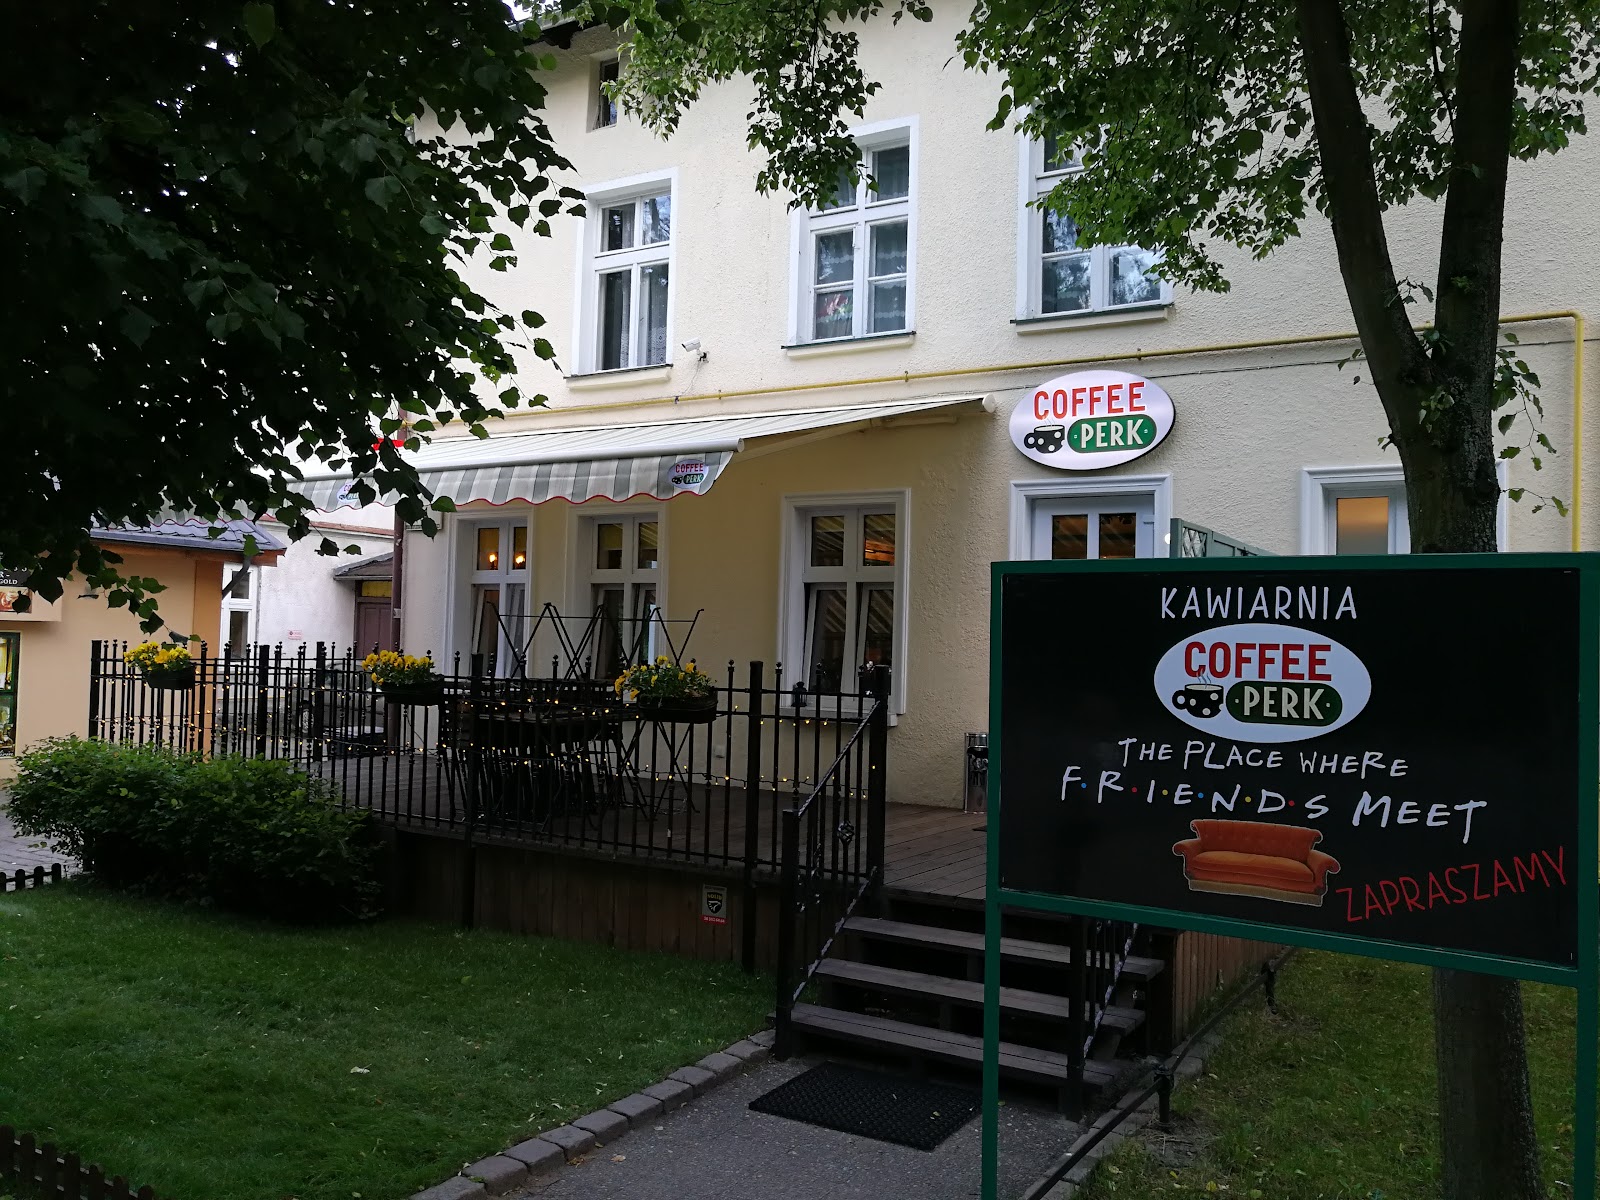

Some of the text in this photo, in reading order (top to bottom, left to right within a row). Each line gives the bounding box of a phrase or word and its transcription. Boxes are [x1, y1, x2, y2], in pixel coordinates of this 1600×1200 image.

[1034, 381, 1145, 420] COFFEE
[1080, 419, 1144, 449] PERK
[675, 463, 704, 473] COFFEE
[686, 474, 702, 483] PERK
[1161, 585, 1358, 621] KAWIARNIA
[1184, 641, 1332, 682] COFFEE
[1242, 686, 1326, 721] PERK
[1118, 737, 1409, 779] THE PLACE WHERE
[1352, 790, 1488, 844] MEET
[1336, 846, 1567, 923] ZAPRASZAMY
